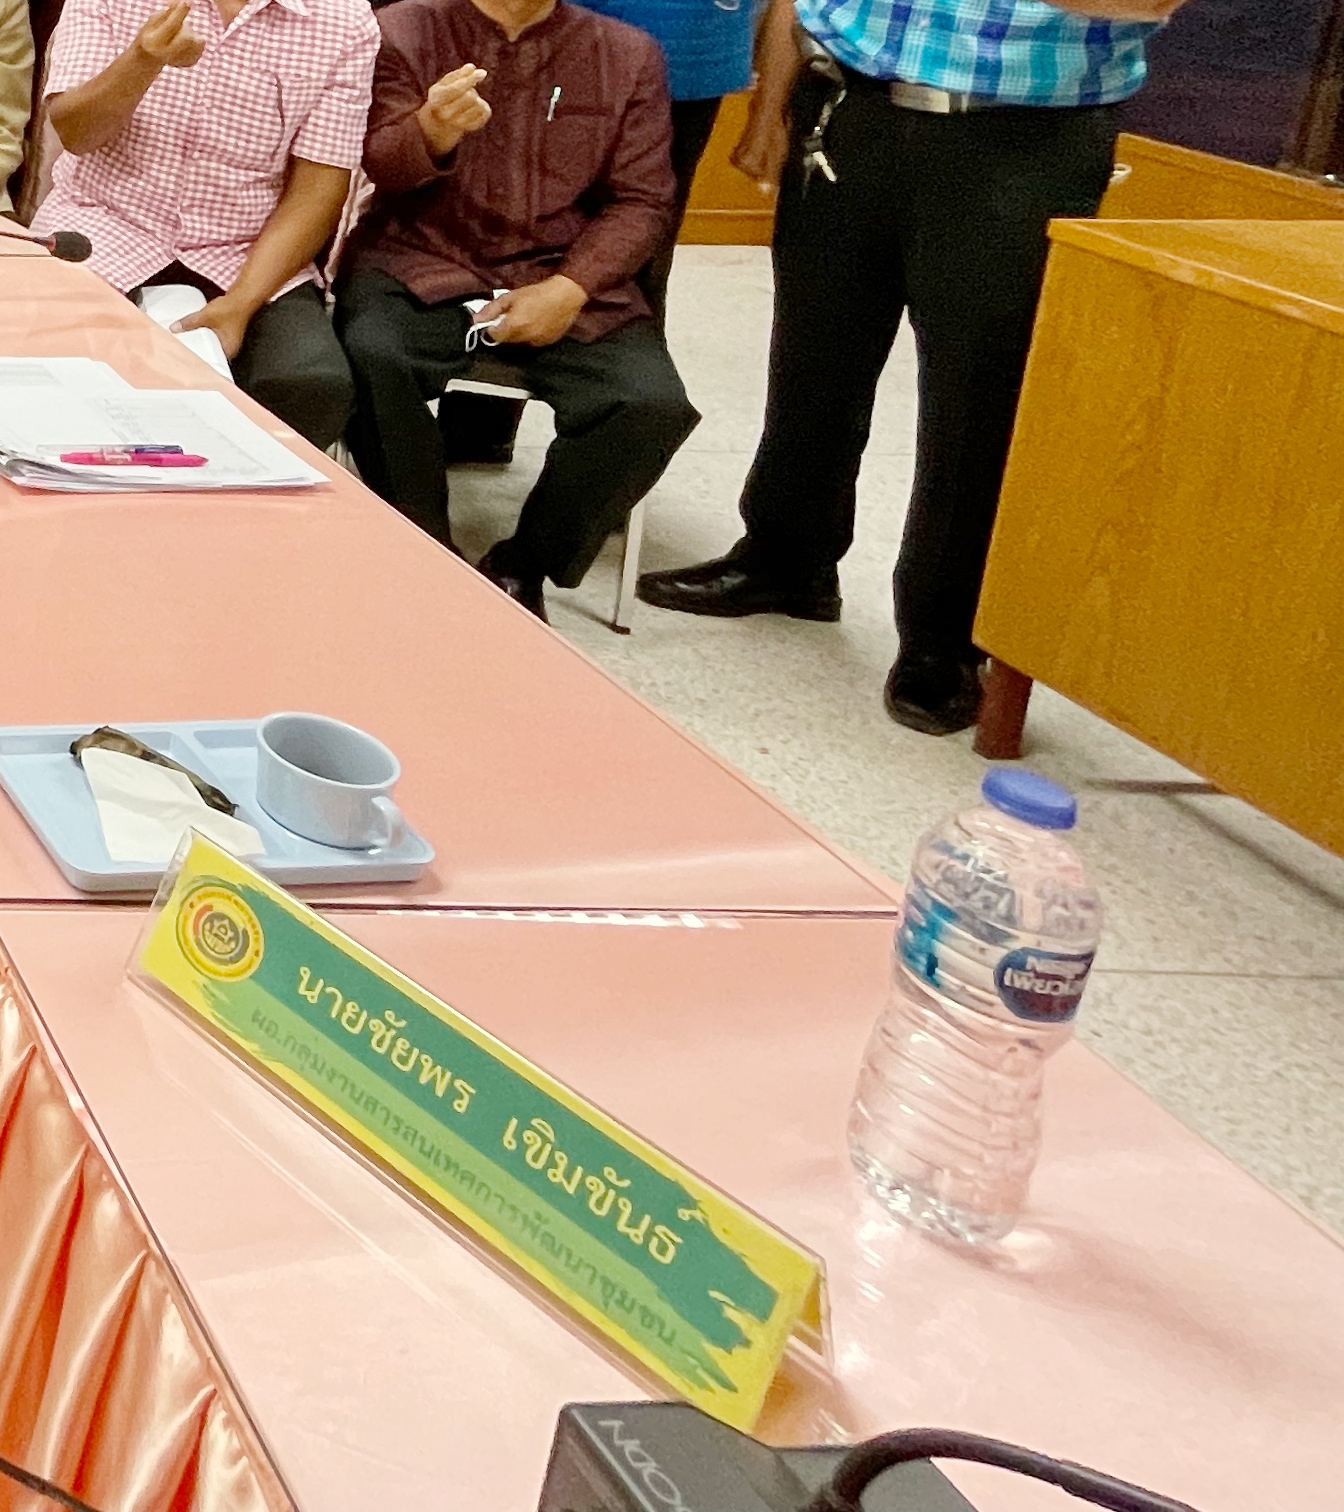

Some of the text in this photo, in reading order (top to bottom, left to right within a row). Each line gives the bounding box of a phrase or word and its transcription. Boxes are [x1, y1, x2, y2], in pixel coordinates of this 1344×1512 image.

[298, 960, 704, 1266] นายชัยพร เขิมขันธ์
